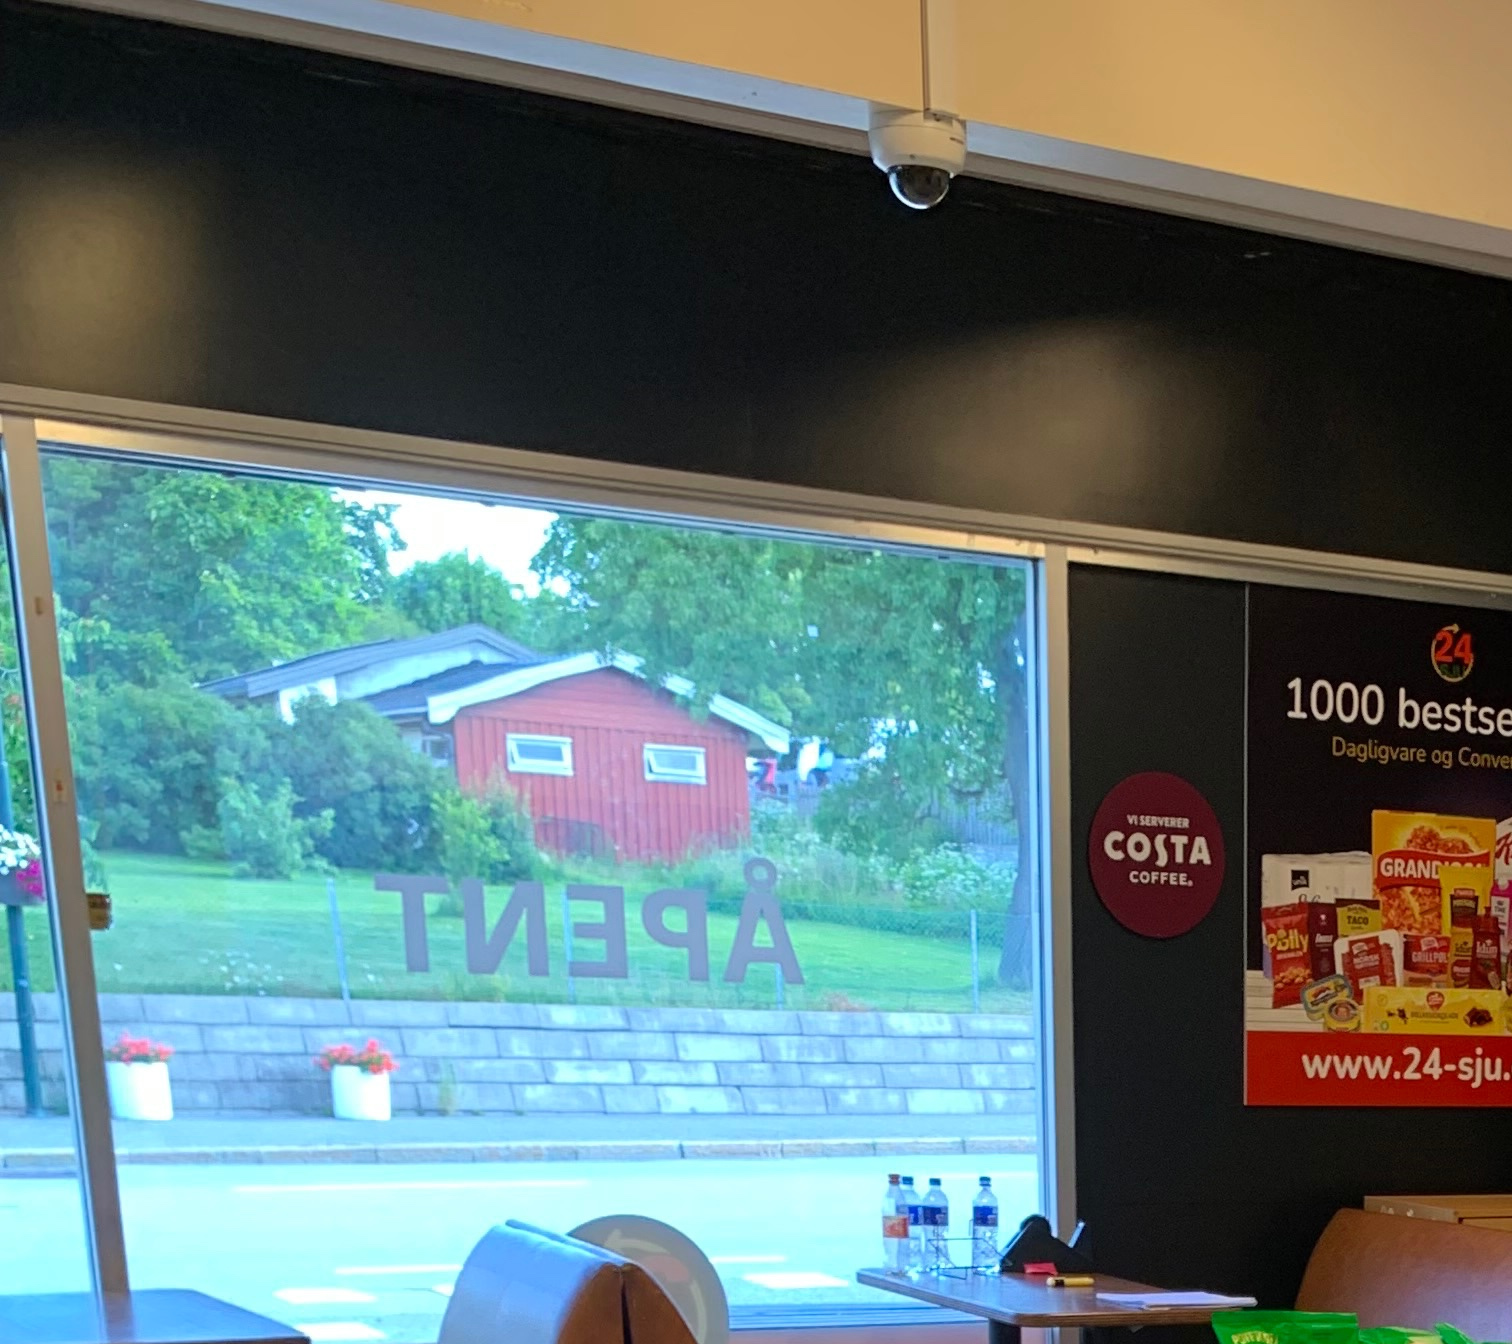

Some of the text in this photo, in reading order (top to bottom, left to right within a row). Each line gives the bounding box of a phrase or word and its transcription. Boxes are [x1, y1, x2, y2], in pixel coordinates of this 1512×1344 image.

[1435, 630, 1473, 664] 24
[1286, 677, 1385, 726] 1000
[1332, 737, 1427, 768] Dagligvare
[1431, 749, 1454, 769] og
[1126, 814, 1190, 828] VI SERVERER
[1103, 830, 1212, 867] COSTA
[1267, 927, 1309, 953] Polly
